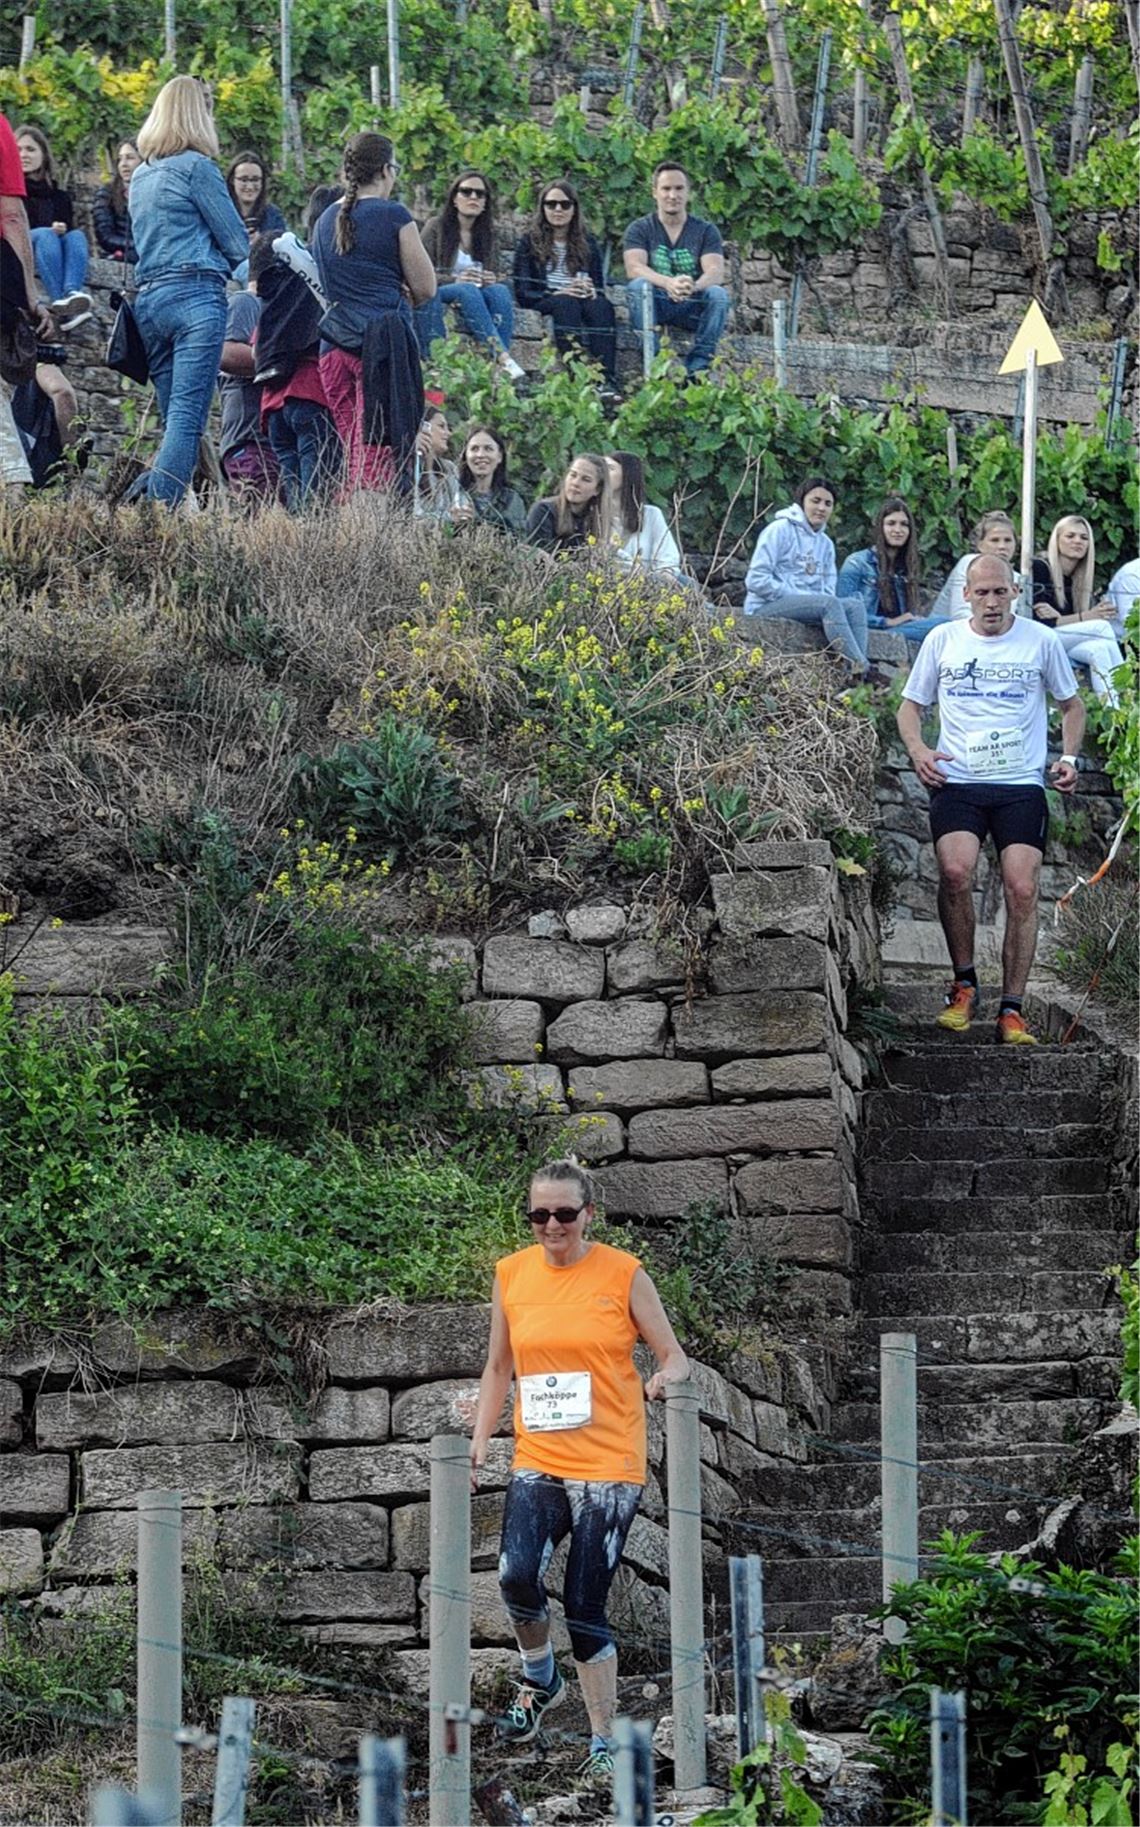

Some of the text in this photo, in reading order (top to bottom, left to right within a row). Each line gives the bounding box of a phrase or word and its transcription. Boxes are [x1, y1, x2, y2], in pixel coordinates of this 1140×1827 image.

[973, 667, 1034, 680] SPORT
[968, 745, 989, 753] TEAM
[1001, 740, 1022, 749] SPORT
